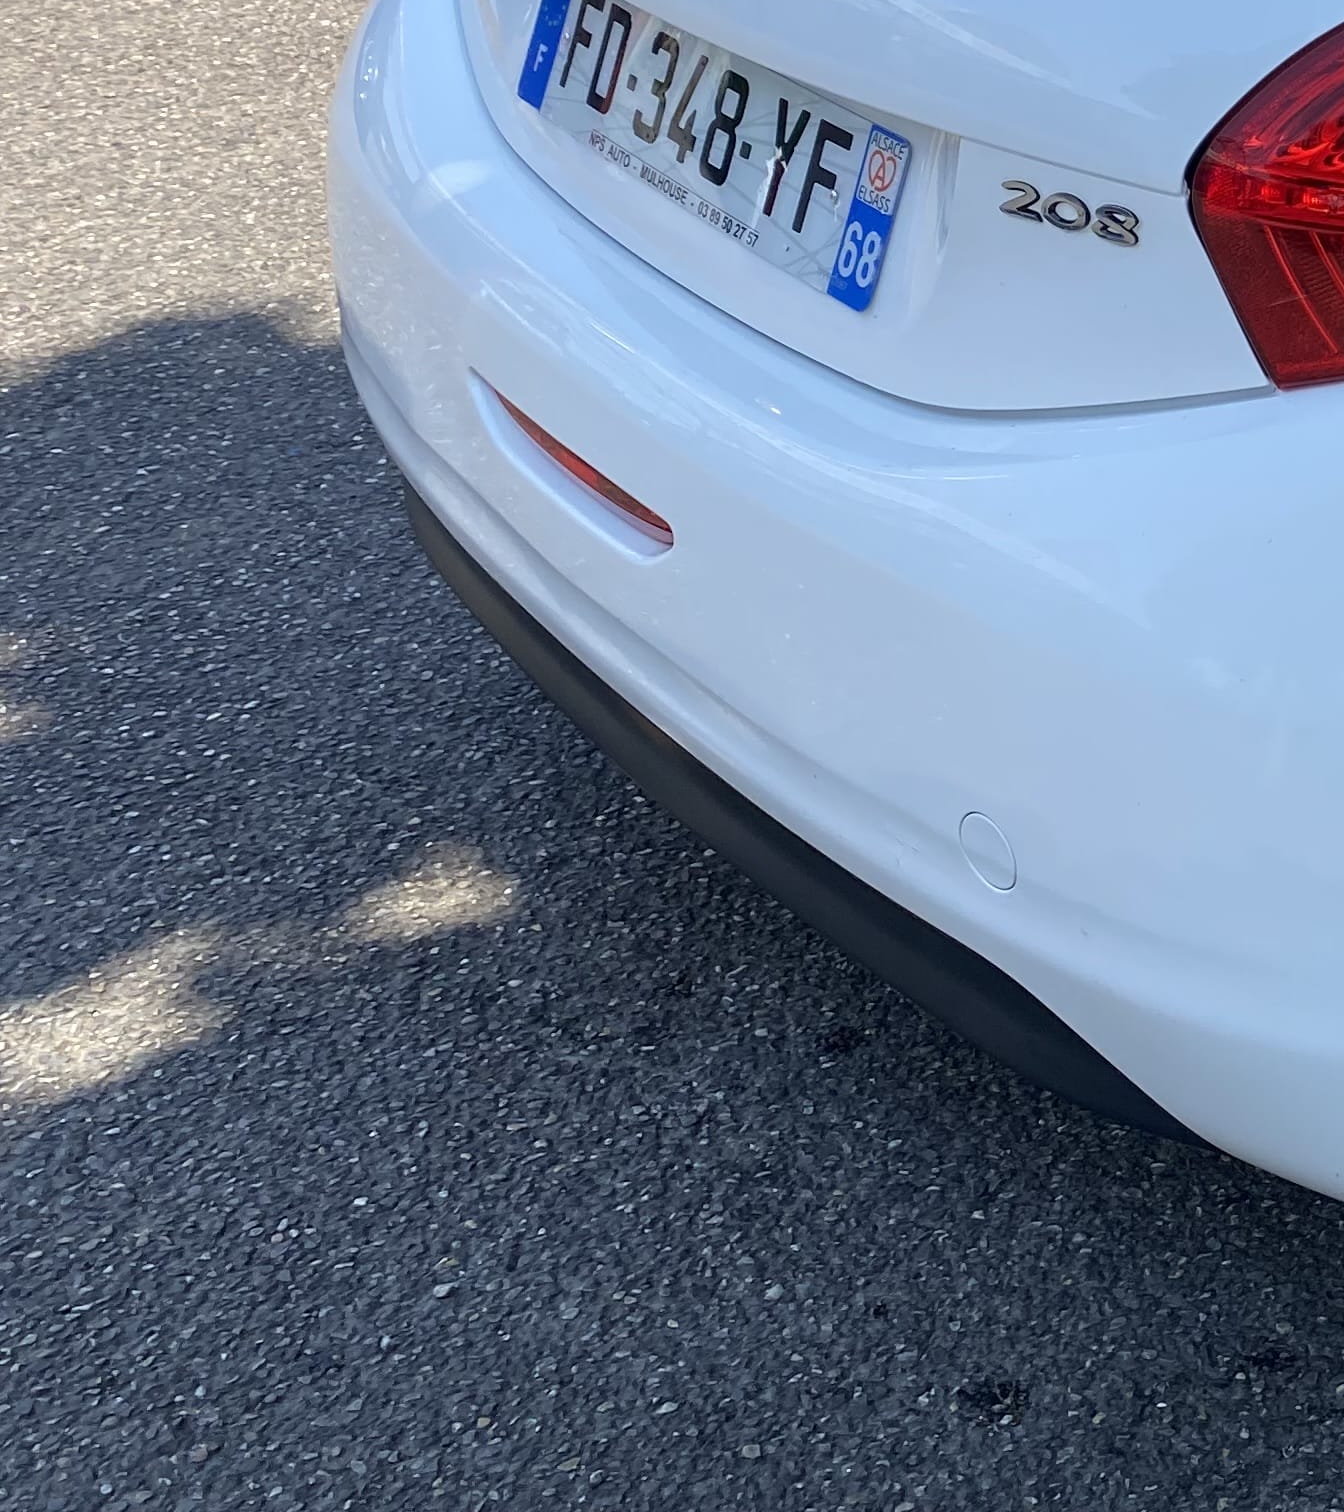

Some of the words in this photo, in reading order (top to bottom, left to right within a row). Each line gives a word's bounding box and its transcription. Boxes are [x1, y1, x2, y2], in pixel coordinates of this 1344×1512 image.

[533, 43, 548, 72] F
[871, 131, 909, 161] ALSACE
[588, 130, 605, 152] NPS
[607, 144, 631, 168] AUTO
[639, 163, 688, 206] MULHOUSE
[697, 201, 708, 218] 03
[709, 208, 721, 225] 89
[721, 216, 733, 234] 50
[733, 223, 747, 239] 27
[746, 231, 759, 247] 57
[858, 184, 891, 214] ELSASS
[999, 179, 1140, 248] 208
[838, 220, 882, 288] 68
